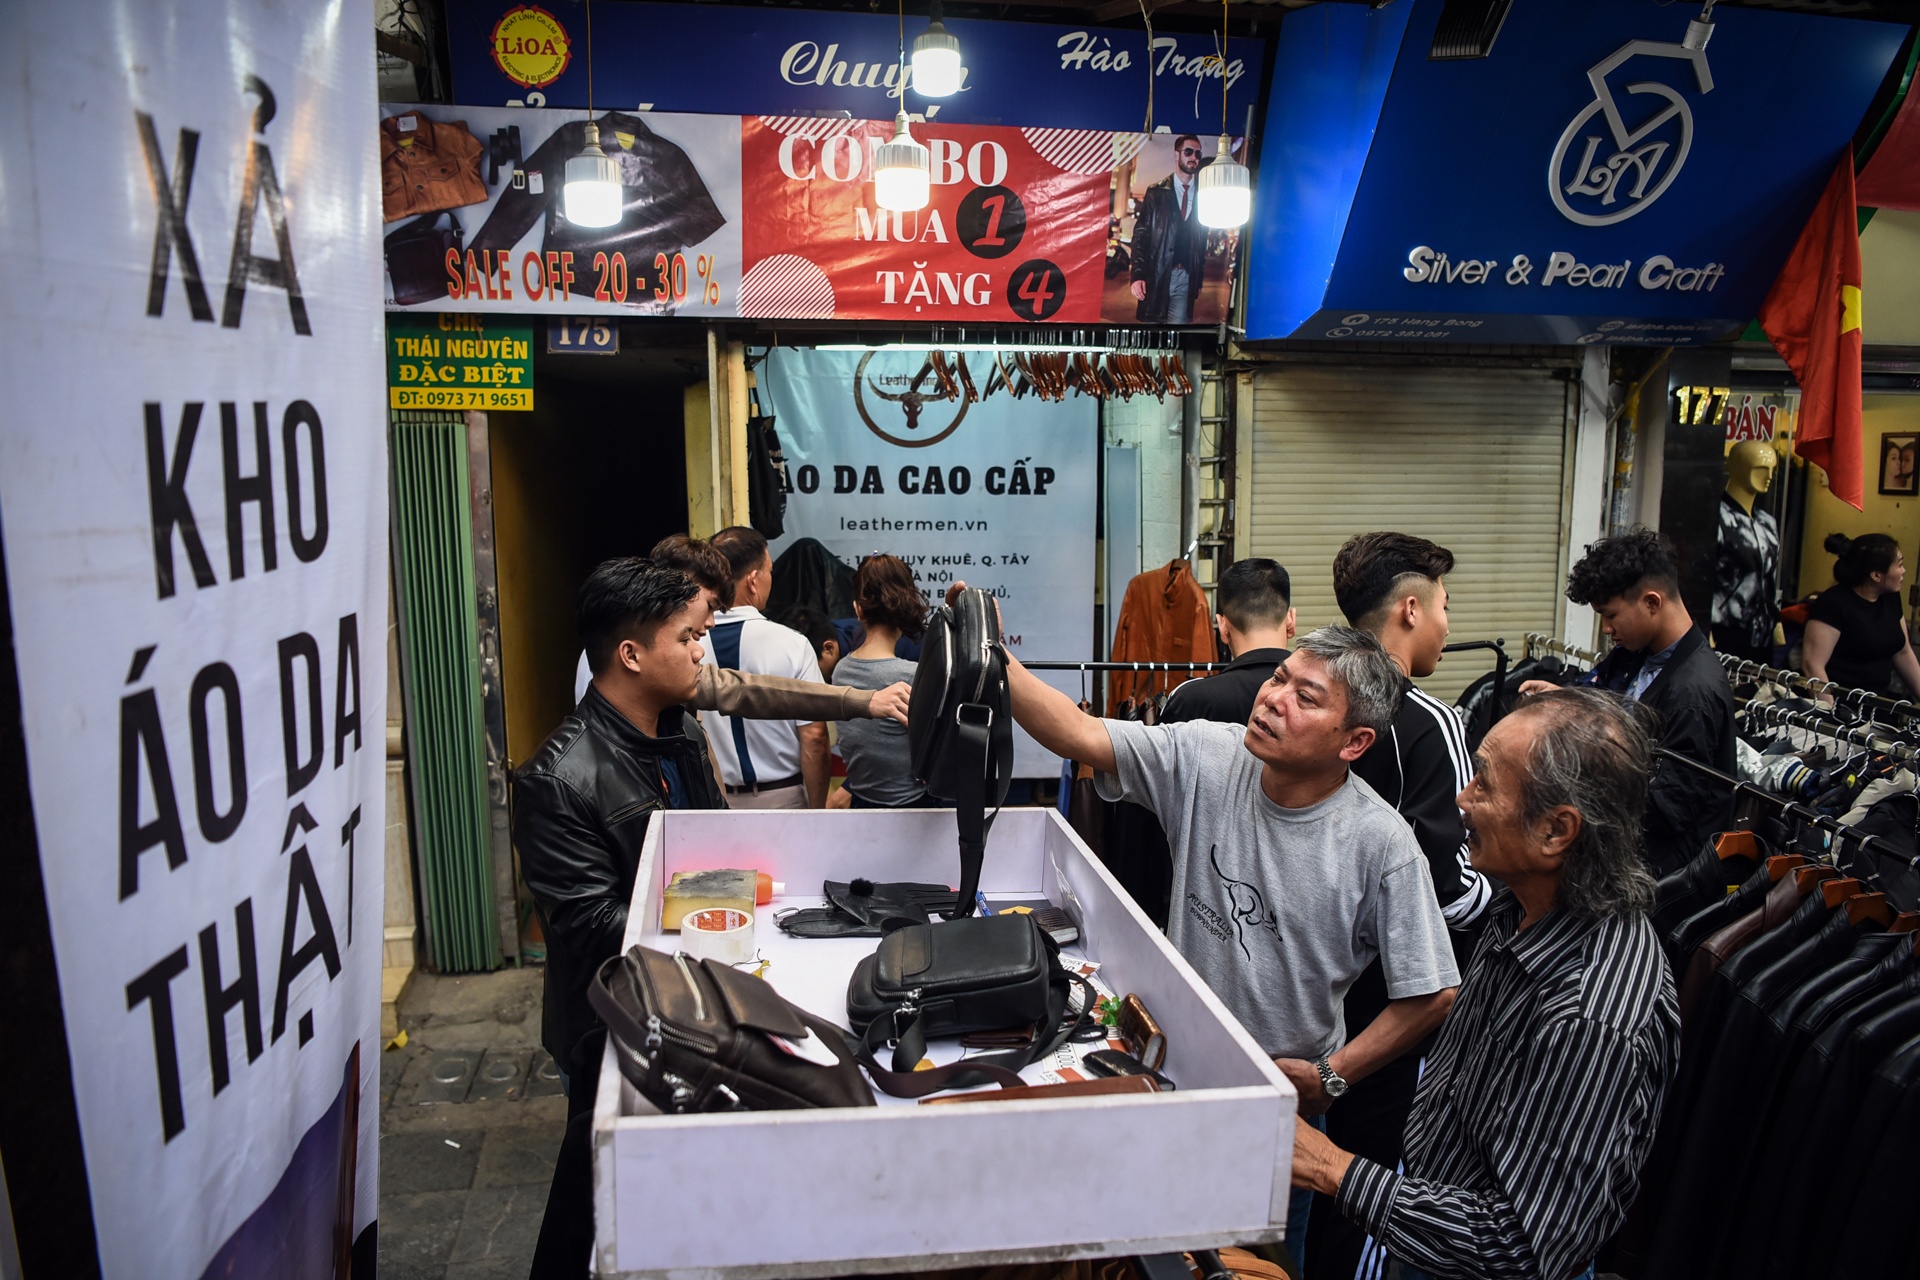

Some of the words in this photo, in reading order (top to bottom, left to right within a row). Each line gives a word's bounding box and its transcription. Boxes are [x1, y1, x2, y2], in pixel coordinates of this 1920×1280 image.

[501, 37, 558, 56] LiOA
[1057, 31, 1132, 72] Hào
[1148, 37, 1246, 91] Trang
[502, 55, 525, 79] ELECTRIC
[135, 73, 313, 336] XẢ
[853, 207, 950, 243] MUA
[972, 194, 1006, 247] 1
[445, 247, 513, 301] SALE
[521, 249, 575, 303] OFF
[593, 251, 629, 304] 20
[653, 252, 688, 305] 30
[697, 253, 721, 307] %
[876, 261, 992, 312] TẶNG
[1017, 271, 1054, 315] 4
[1403, 245, 1498, 284] Silver
[1504, 253, 1534, 286] &
[1541, 251, 1632, 289] Pearl
[1638, 254, 1725, 293] Craft
[558, 317, 611, 346] 175
[1401, 318, 1441, 327] Hang
[1443, 319, 1484, 328] Bong
[395, 335, 441, 357] THÁI
[447, 336, 528, 360] NGUYÊN
[399, 360, 456, 387] ĐẶC
[463, 362, 525, 388] BIỆT
[398, 391, 424, 406] ĐT:
[427, 391, 464, 406] 0973
[468, 393, 485, 406] 71
[490, 393, 527, 407] 9651
[1674, 385, 1731, 425] 177
[1726, 395, 1779, 442] BÁN
[833, 465, 885, 495] DA
[898, 465, 971, 495] CAO
[984, 457, 1056, 495] CẤP
[143, 399, 329, 601] KHO
[840, 516, 988, 532] leathermen.vn
[928, 569, 953, 584] NỘI
[931, 554, 977, 567] KHUÊ,
[981, 555, 997, 567] Q.
[1001, 554, 1030, 565] TÂY
[118, 643, 249, 903] ÁO
[277, 612, 363, 800] DA
[1187, 892, 1235, 940] AUSTRALIA
[124, 802, 363, 1147] THẬT
